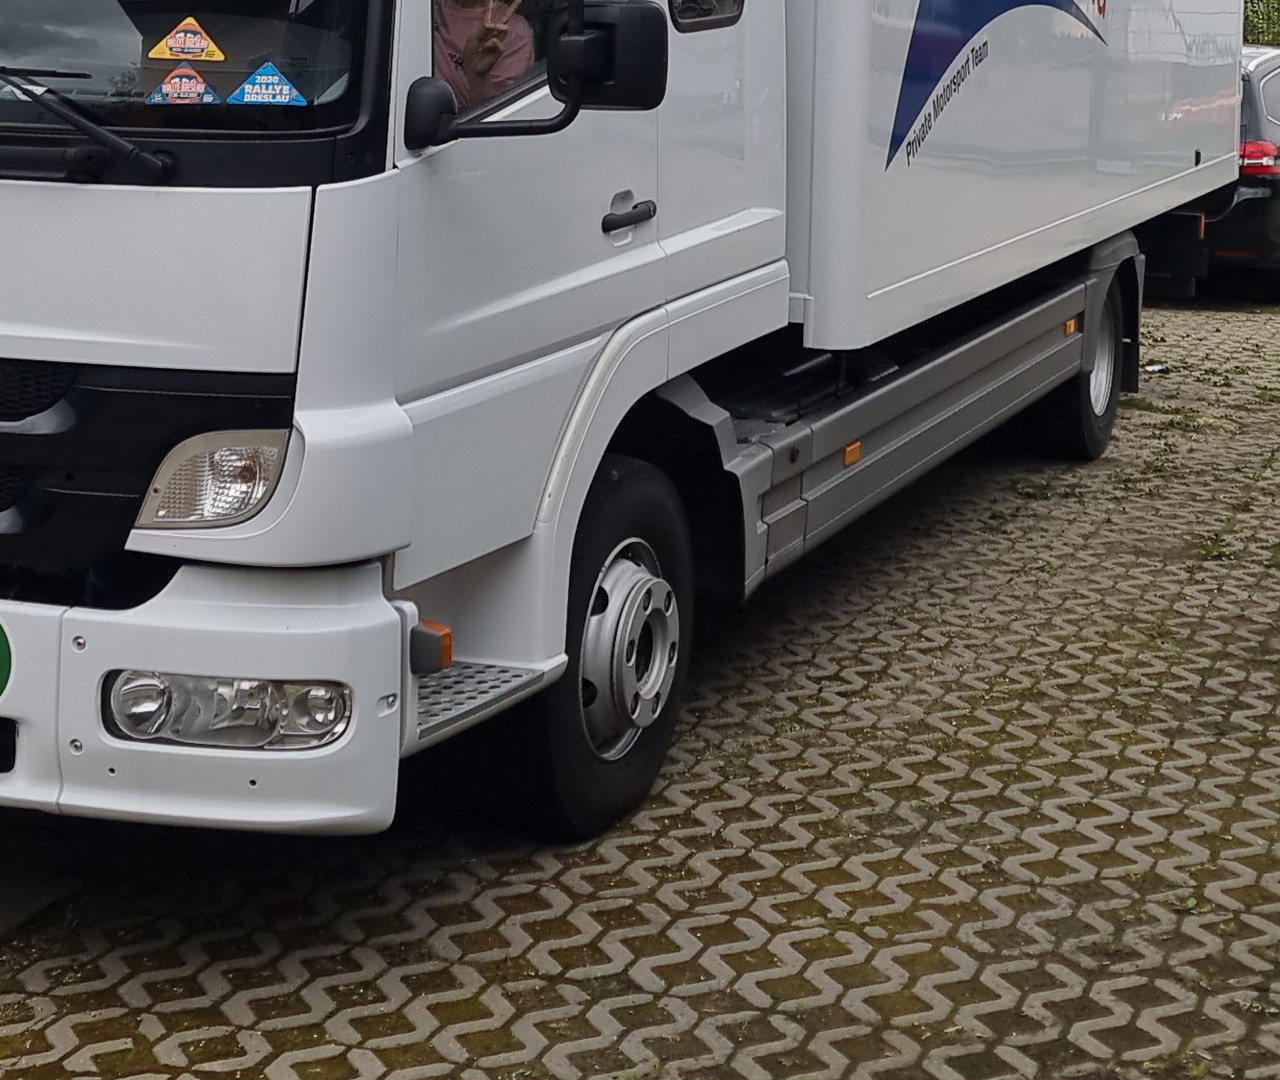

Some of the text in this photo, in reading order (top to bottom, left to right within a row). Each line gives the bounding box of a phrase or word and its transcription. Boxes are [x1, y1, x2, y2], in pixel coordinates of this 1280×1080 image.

[255, 75, 279, 83] 2020
[244, 84, 290, 94] RALLYE
[244, 94, 291, 102] BRESLAU
[906, 40, 989, 167] Private Motorsport Team
